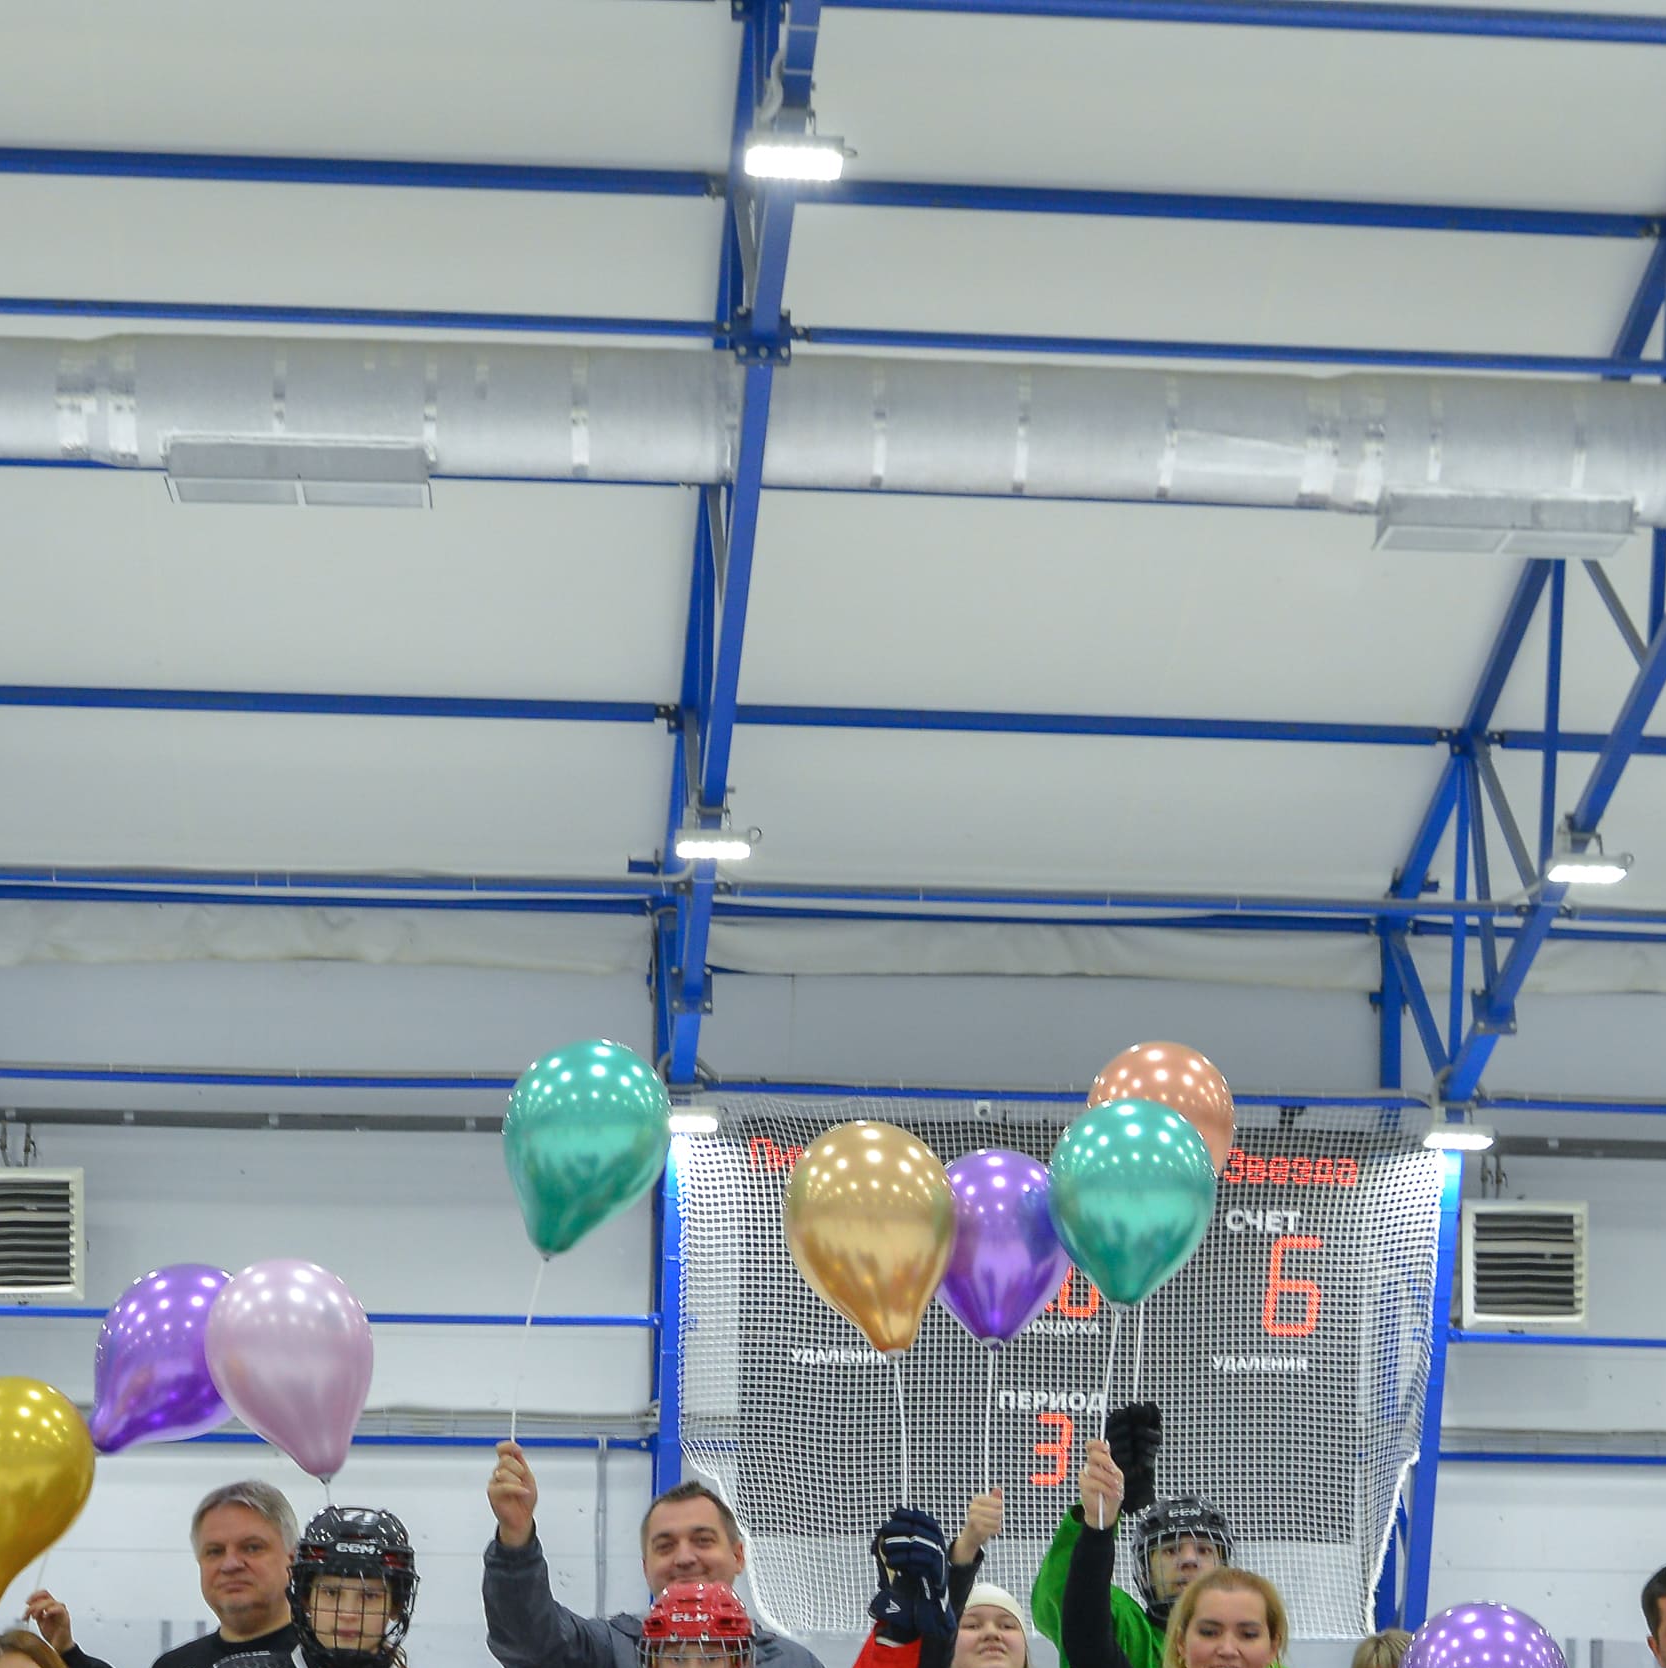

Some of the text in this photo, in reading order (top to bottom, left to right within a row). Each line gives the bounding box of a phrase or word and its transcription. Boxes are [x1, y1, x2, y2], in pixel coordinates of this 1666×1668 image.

[750, 1137, 803, 1172] Пи
[1224, 1148, 1357, 1186] Звезда
[1225, 1209, 1301, 1232] СЧЕТ
[1262, 1235, 1323, 1337] 6
[1212, 1356, 1309, 1373] УДАЛЕНИЯ
[999, 1389, 1106, 1414] ПЕРИОД
[1030, 1413, 1074, 1486] 3
[335, 1542, 376, 1555] CCM
